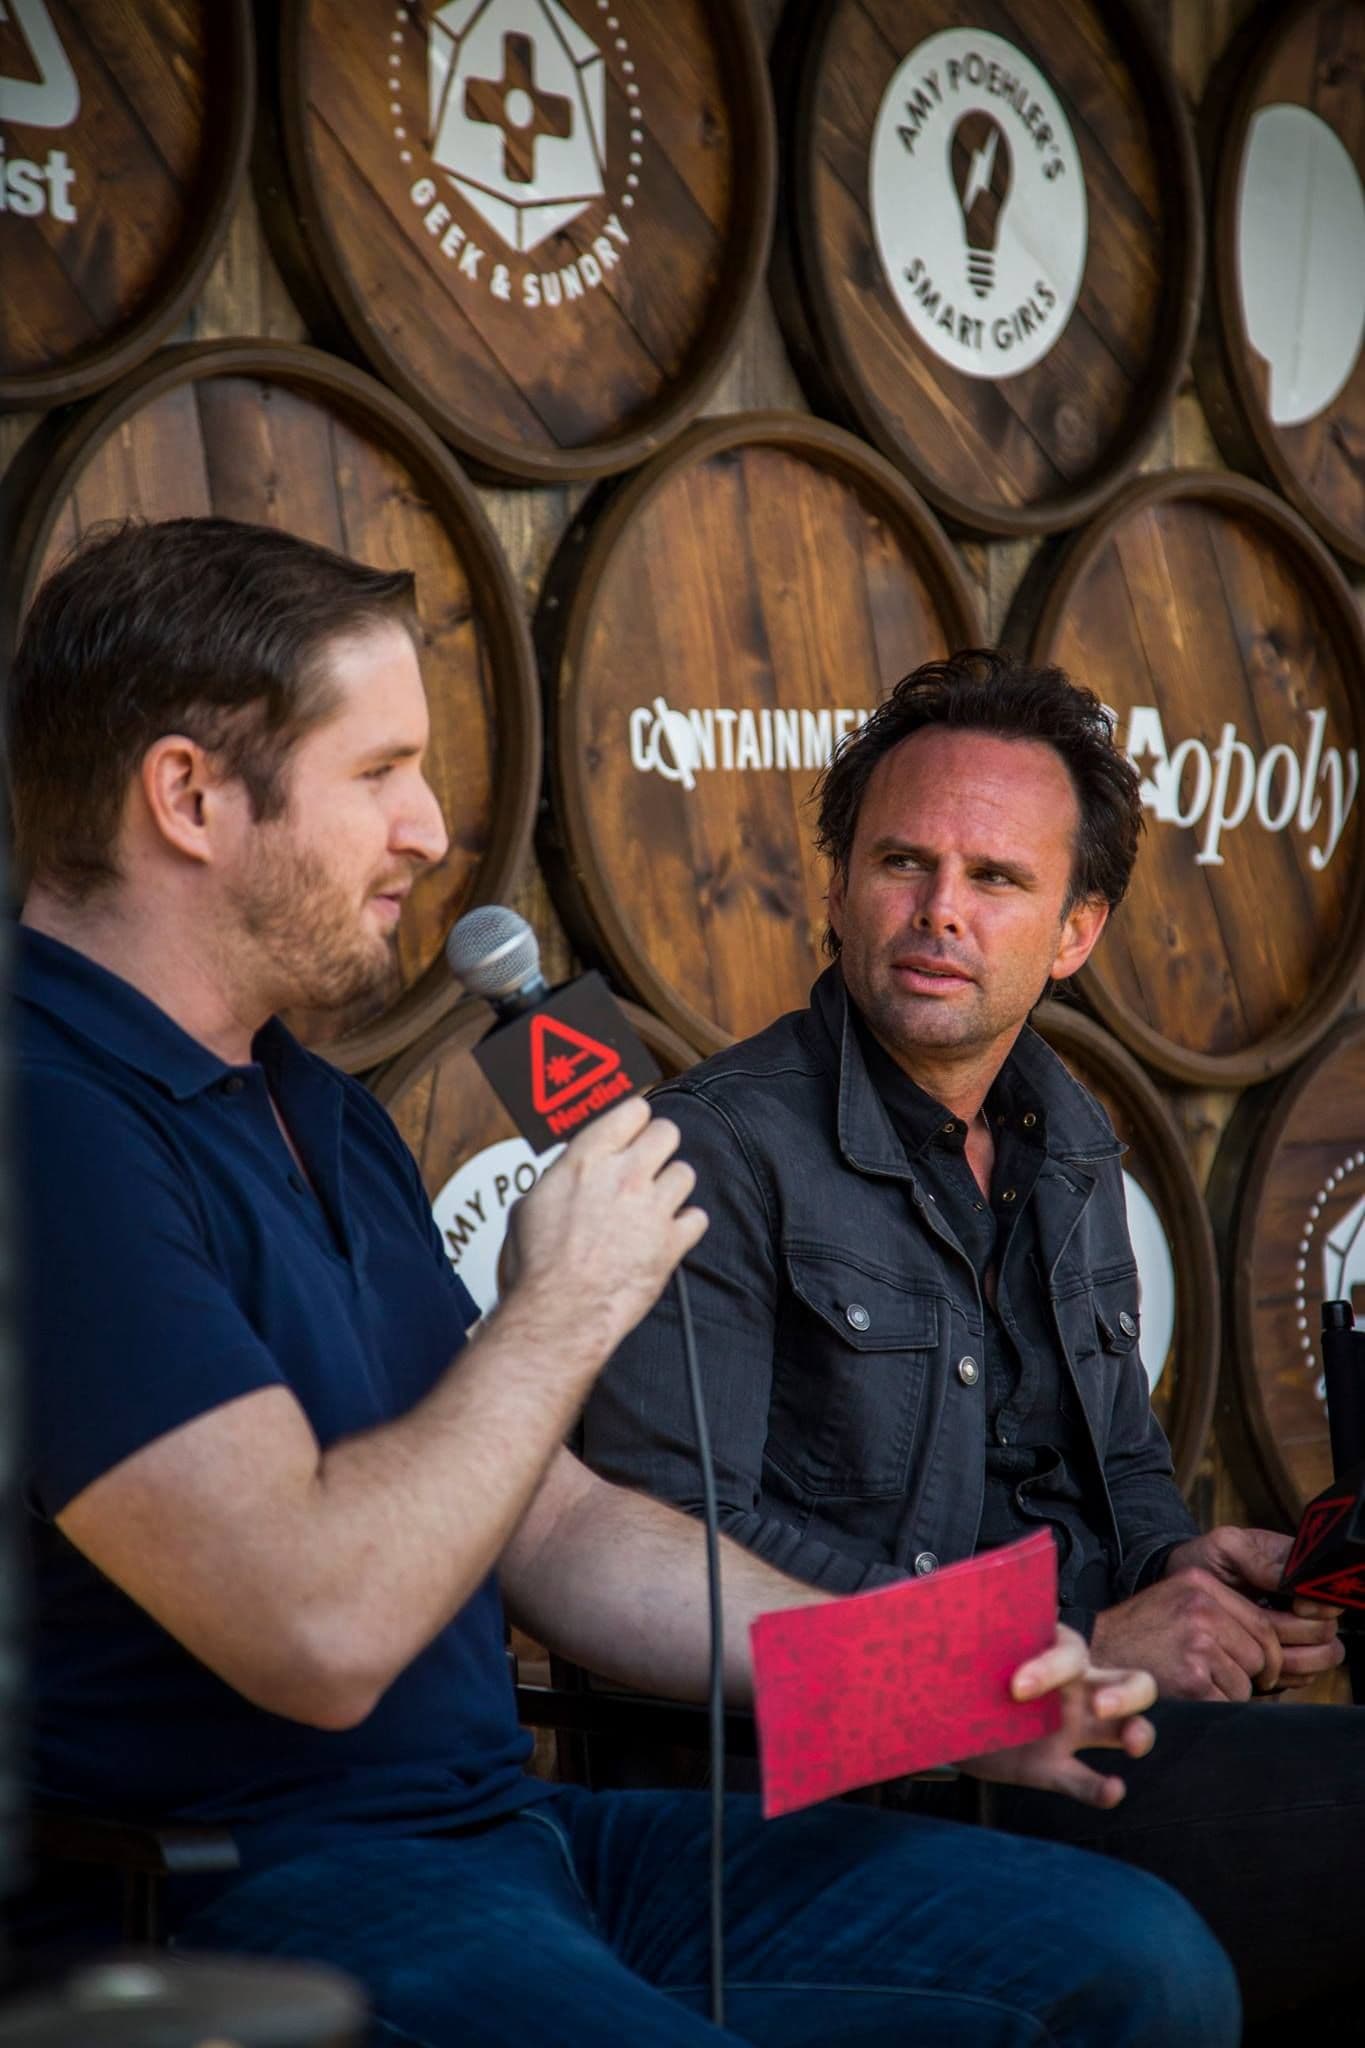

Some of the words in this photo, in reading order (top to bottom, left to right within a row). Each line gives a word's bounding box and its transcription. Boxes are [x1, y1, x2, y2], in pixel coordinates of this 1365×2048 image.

[896, 69, 943, 156] AMY
[946, 52, 1066, 182] POEHLER'S
[0, 136, 79, 224] st
[410, 177, 486, 280] GEEK
[490, 263, 511, 301] &
[522, 213, 630, 307] SUNDRY
[904, 257, 984, 351] SMART
[991, 279, 1057, 350] GIRLS
[629, 696, 880, 791] CONTAINME
[1099, 703, 1360, 871] Aopoly
[444, 1188, 487, 1266] MY
[493, 1162, 550, 1208] PO
